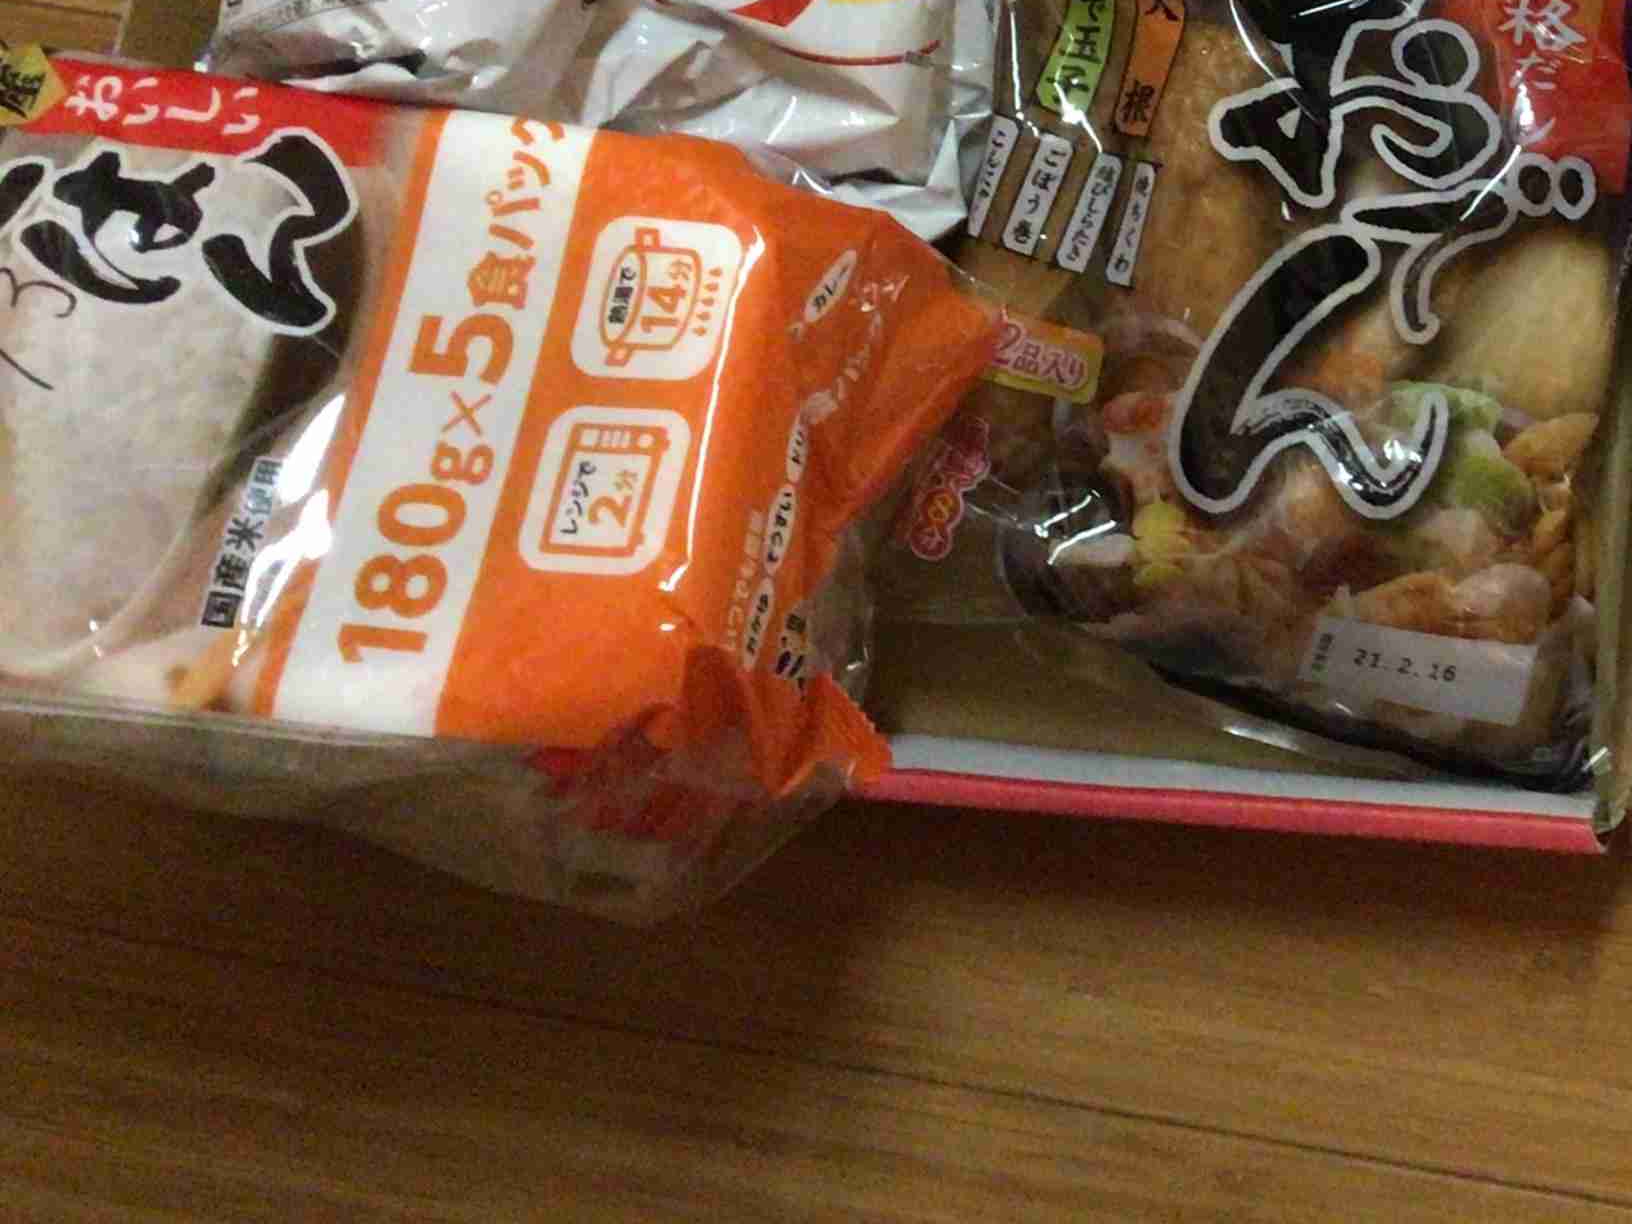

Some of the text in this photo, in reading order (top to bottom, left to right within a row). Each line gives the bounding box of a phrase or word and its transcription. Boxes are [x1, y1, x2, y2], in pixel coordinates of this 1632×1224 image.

[65, 74, 262, 138] おいしい
[0, 133, 352, 330] はん
[1011, 147, 1066, 249] ごぼう巻
[641, 258, 695, 334] 14分
[558, 459, 599, 538] レンジで
[588, 468, 642, 531] 2分
[1352, 647, 1458, 683] 21.2.16
